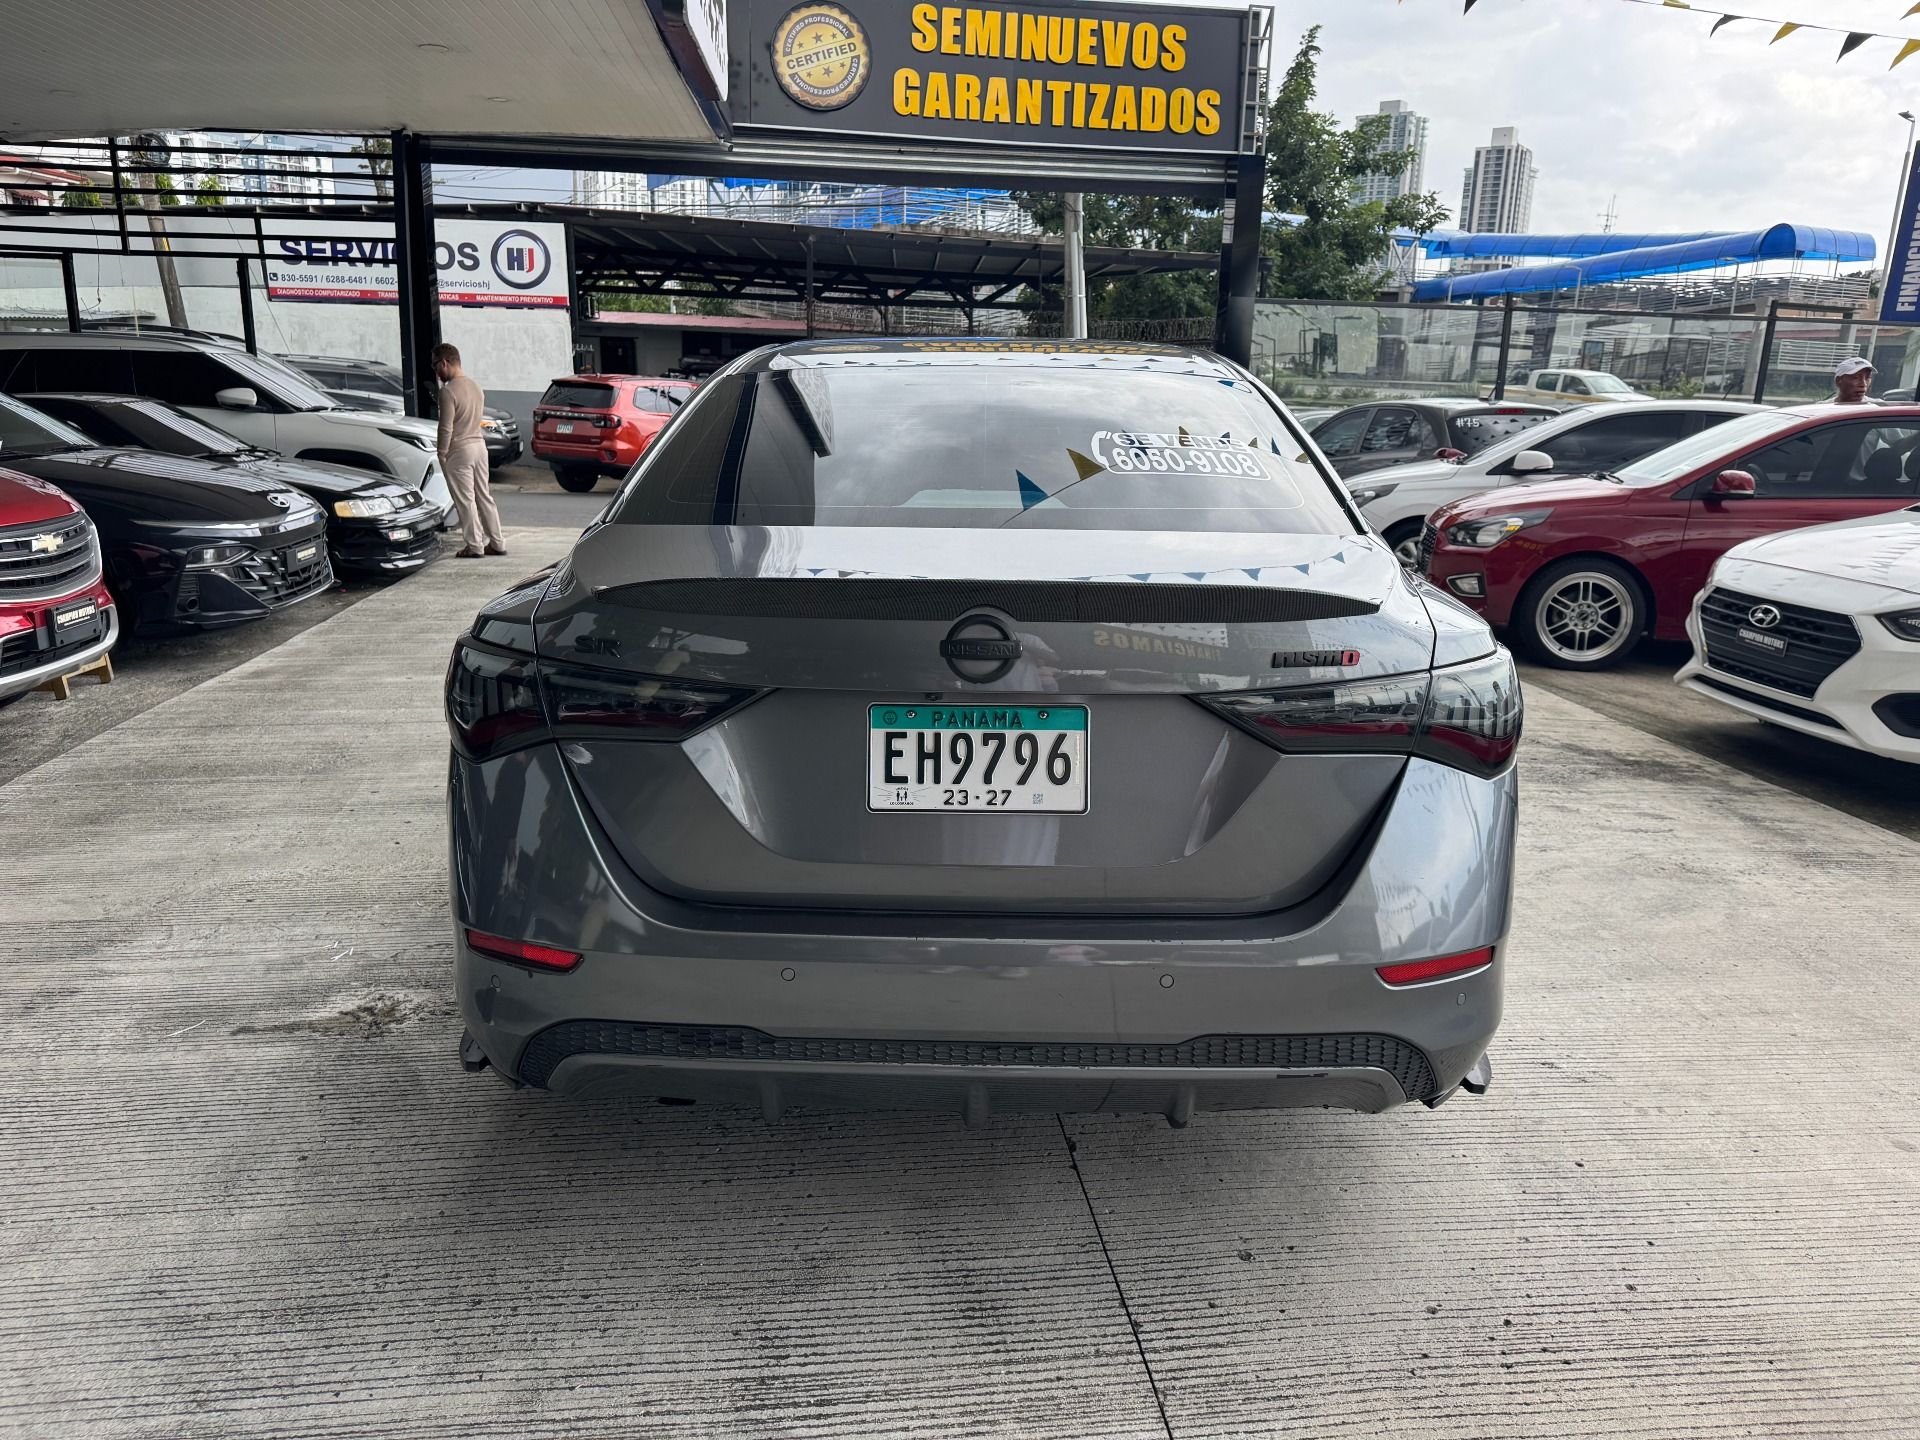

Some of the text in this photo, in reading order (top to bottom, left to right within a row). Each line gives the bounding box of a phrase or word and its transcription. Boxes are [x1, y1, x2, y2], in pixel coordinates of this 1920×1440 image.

[785, 16, 849, 52] CERTIFIED PROFESSIONAL
[911, 3, 1187, 72] SEMINUEVOS
[786, 42, 857, 70] CERTIFIED
[893, 68, 1221, 135] GARANTIZADOS
[279, 239, 480, 272] SERVIOS
[281, 273, 318, 283] 830-5591
[325, 275, 368, 285] 6288-6481
[314, 289, 361, 298] COMPUTARIZADO
[1119, 432, 1154, 447] SE
[1112, 447, 1261, 477] 6050-9108
[948, 642, 1015, 656] NISSAN
[932, 710, 1024, 729] PANAMA
[884, 731, 1073, 787] EH9796
